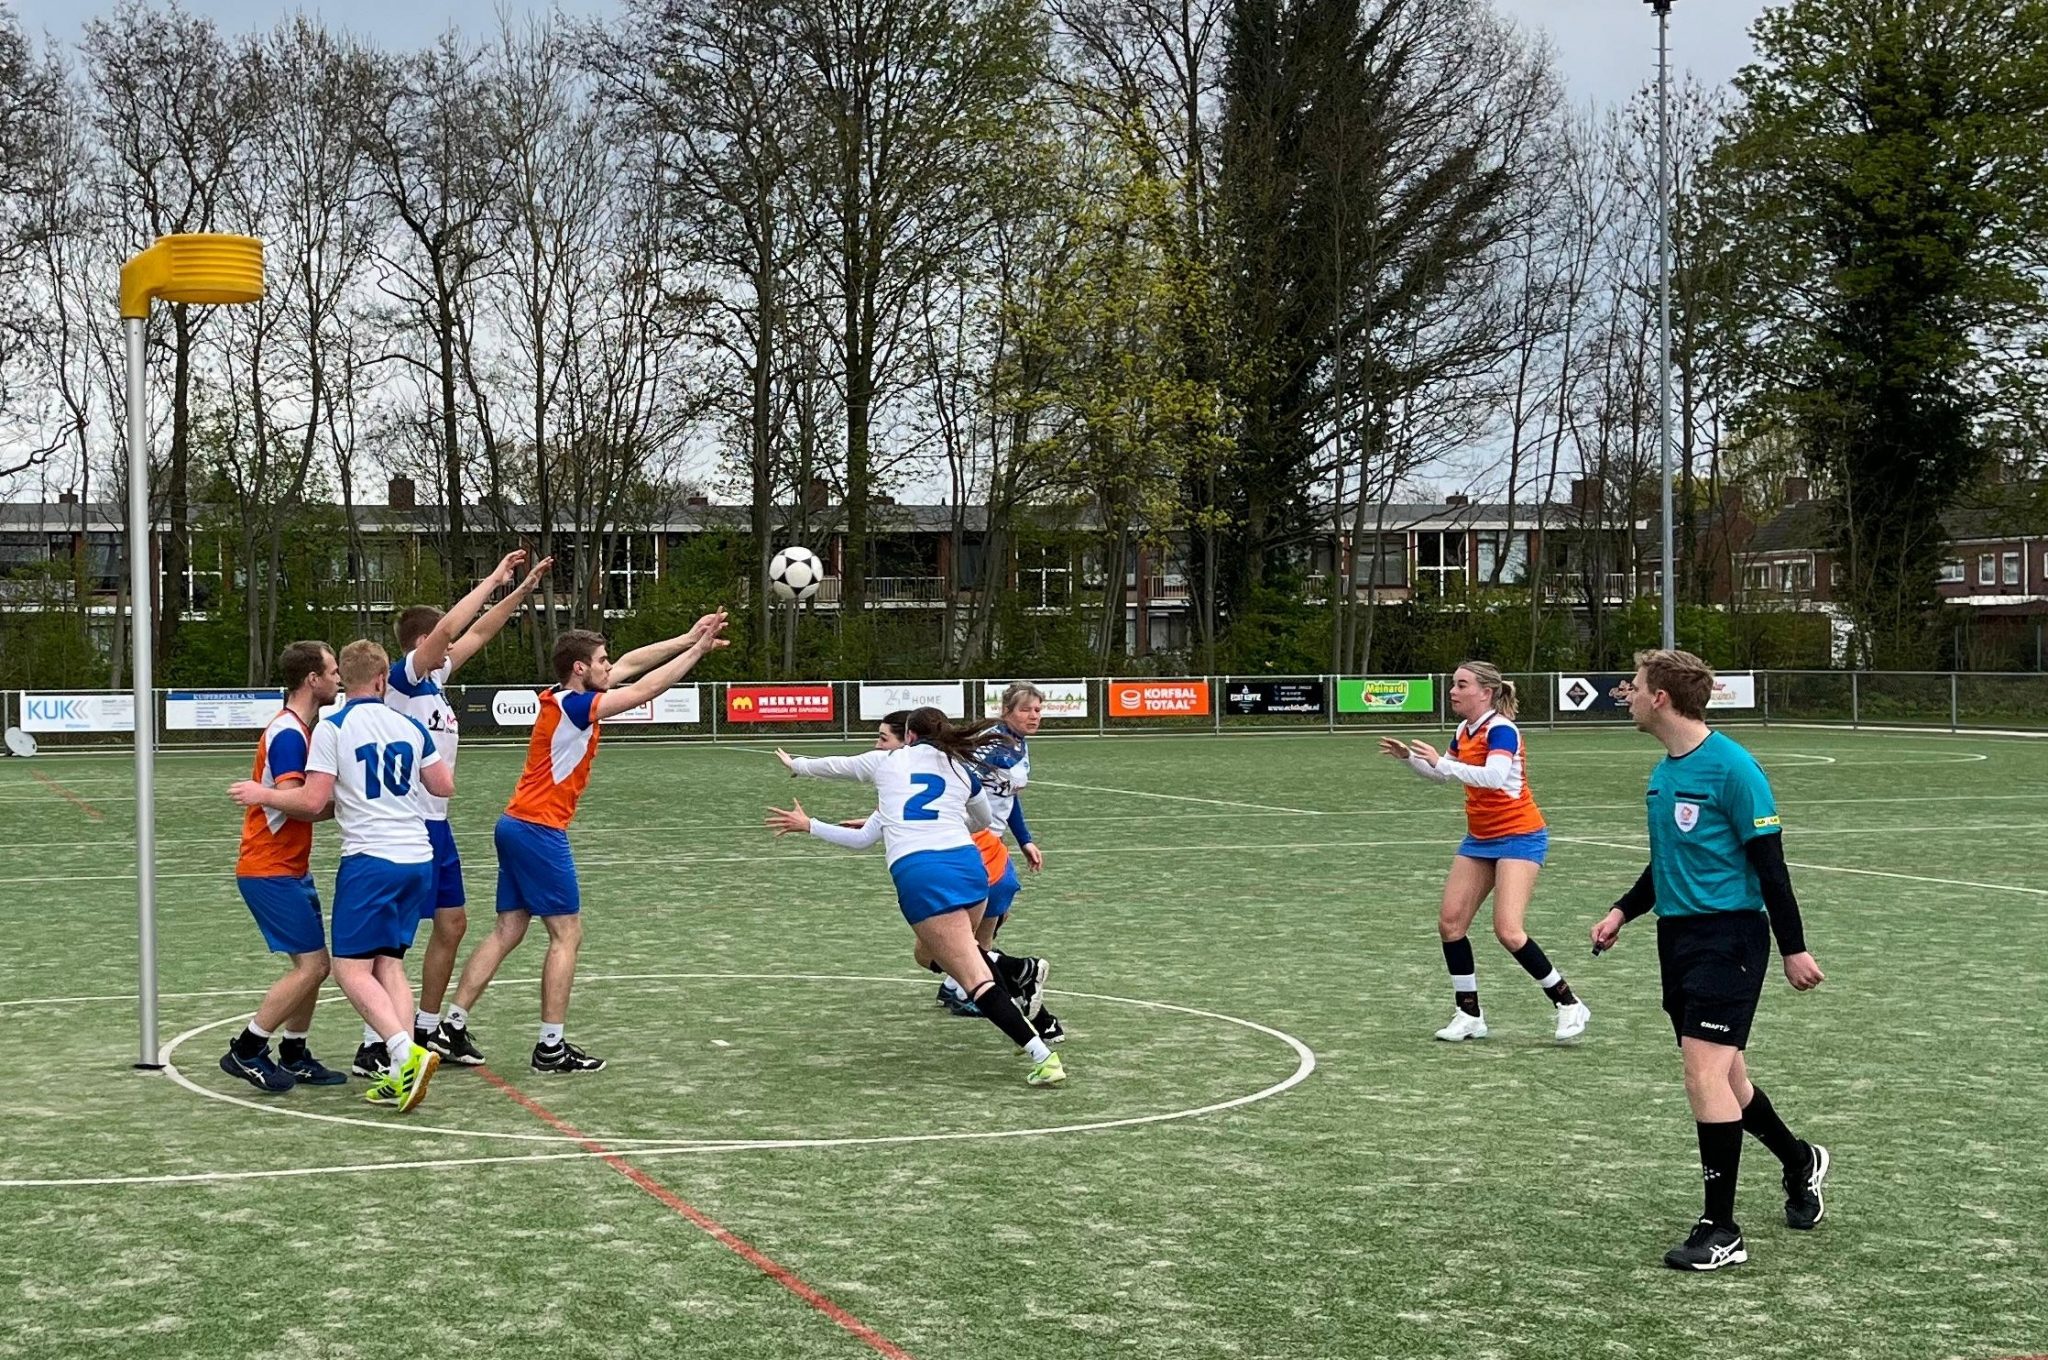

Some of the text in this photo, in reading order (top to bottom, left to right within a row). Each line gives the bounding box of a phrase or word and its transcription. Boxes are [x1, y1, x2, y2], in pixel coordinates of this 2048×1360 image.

[1144, 688, 1197, 699] KORFBAL
[1366, 683, 1407, 693] Meinardi
[758, 696, 829, 706] MEERTENS
[911, 696, 942, 705] HOME
[1145, 700, 1191, 711] TOTAAL
[496, 703, 536, 714] Goud
[355, 741, 414, 800] 10
[903, 773, 946, 821] 2
[1701, 1021, 1724, 1031] CRAFT
